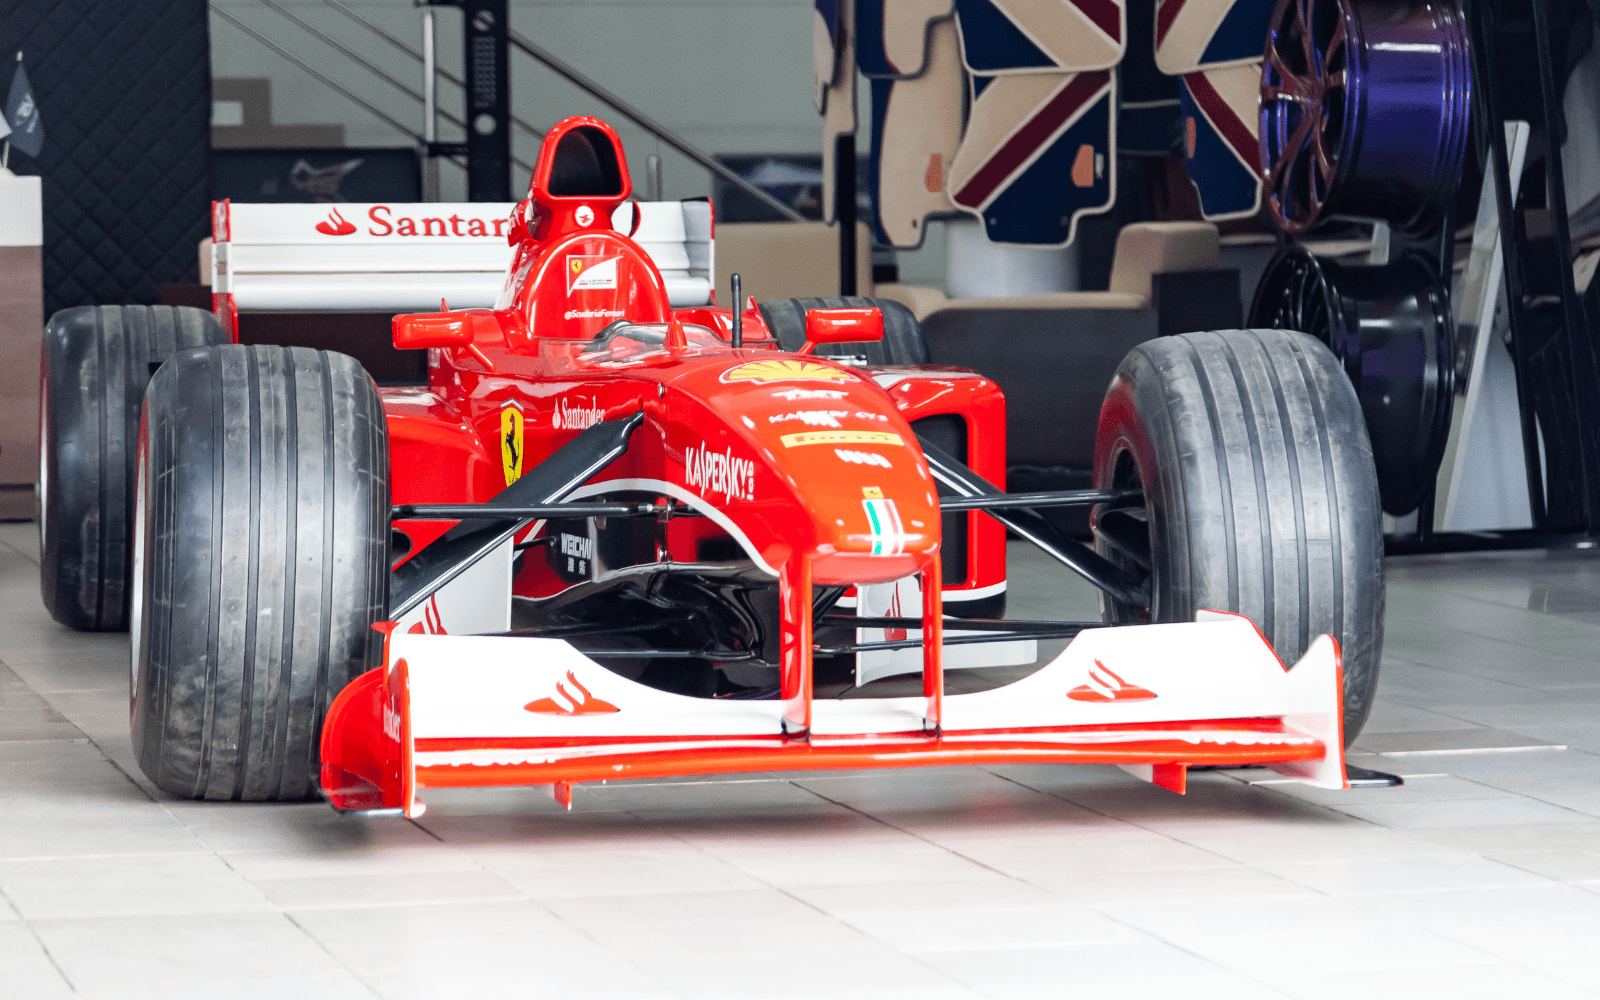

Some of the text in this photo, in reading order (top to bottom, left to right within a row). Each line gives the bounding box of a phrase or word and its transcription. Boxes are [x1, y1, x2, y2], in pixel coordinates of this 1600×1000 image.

[564, 308, 626, 320] @ScuderiaFerrari
[562, 394, 606, 430] Santander
[685, 439, 748, 506] KASPERSKY
